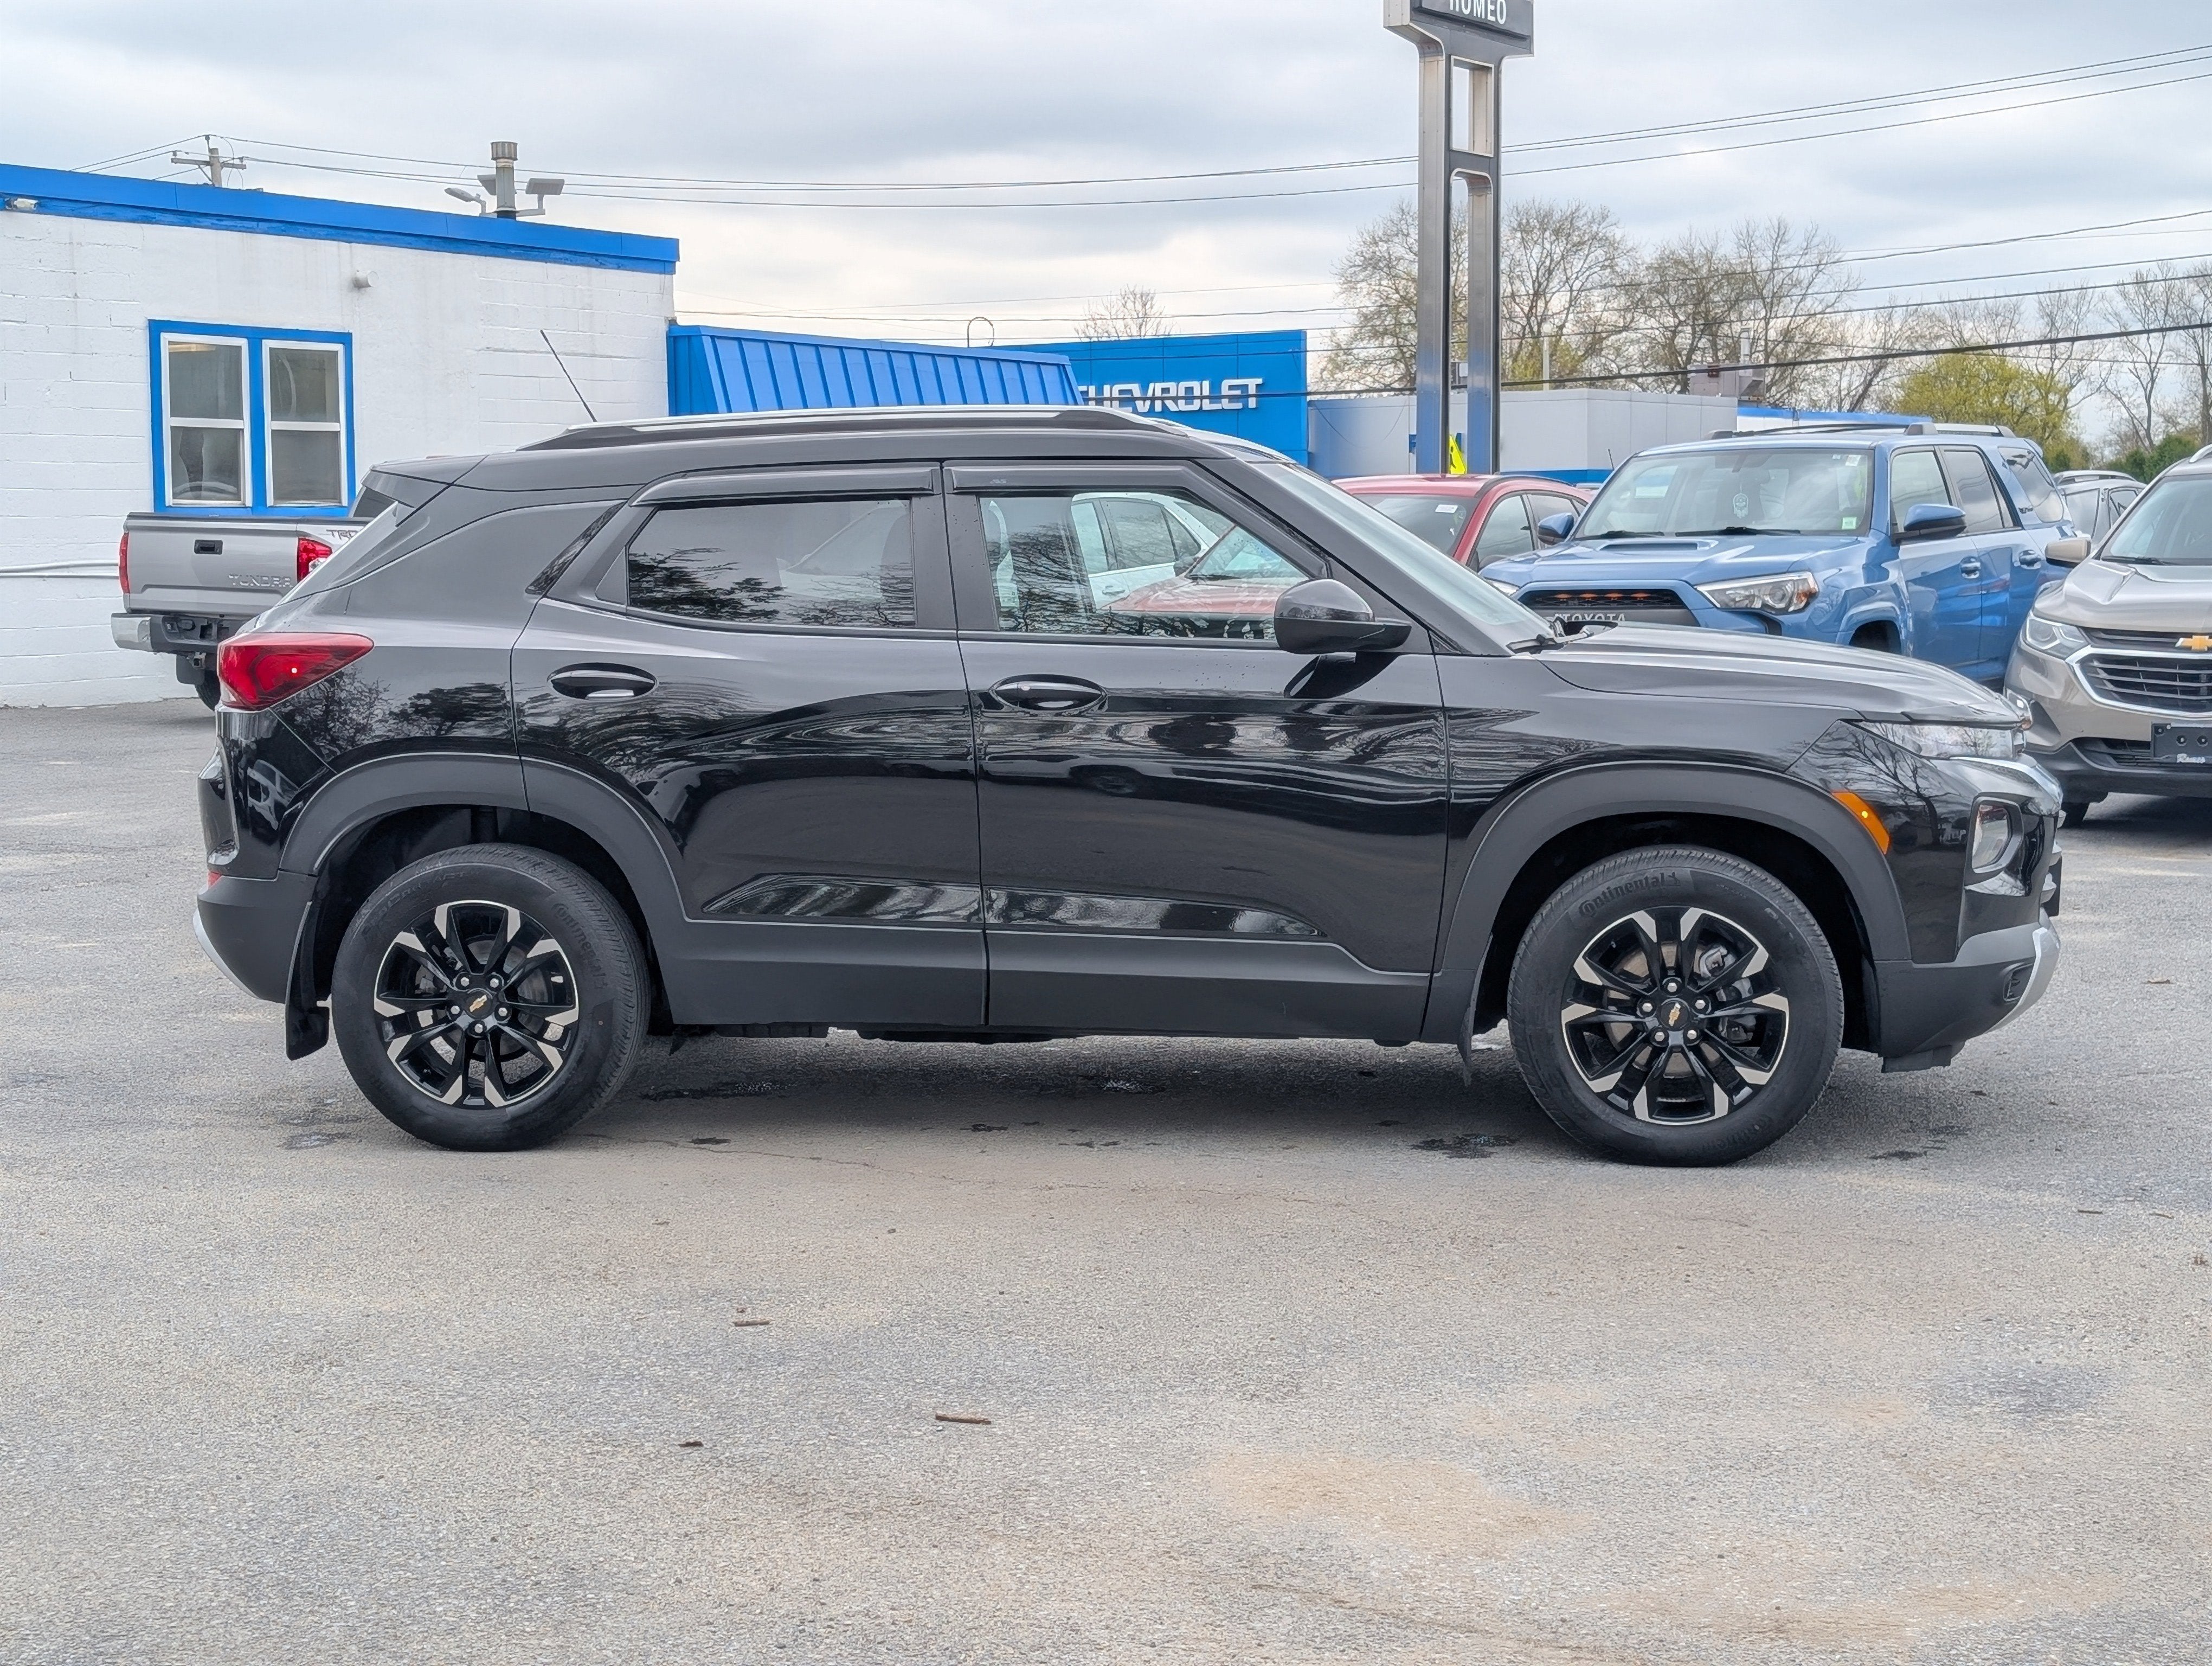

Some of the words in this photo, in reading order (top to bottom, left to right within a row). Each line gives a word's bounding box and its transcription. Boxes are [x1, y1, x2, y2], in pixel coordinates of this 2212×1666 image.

[1078, 378, 1263, 413] HEVROLET
[228, 574, 294, 587] TUNDRA
[1578, 872, 1665, 918] Continental
